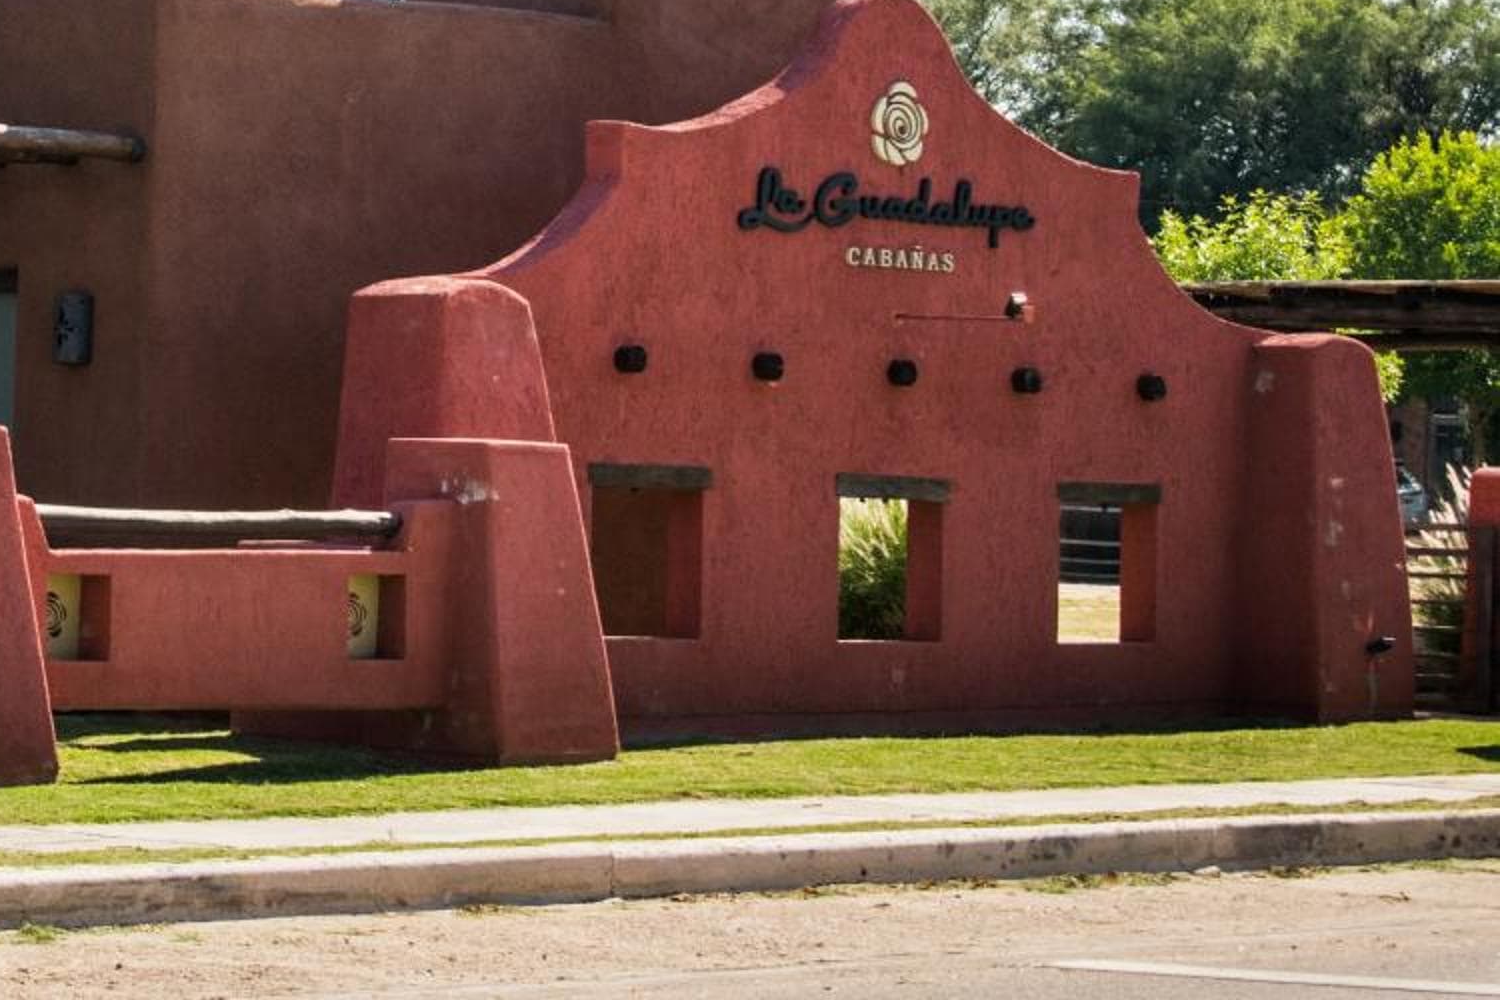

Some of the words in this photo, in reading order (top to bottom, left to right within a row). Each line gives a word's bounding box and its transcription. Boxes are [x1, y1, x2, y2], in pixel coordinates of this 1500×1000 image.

[737, 166, 813, 232] La
[813, 172, 1035, 248] Guadalupe
[846, 245, 956, 273] CABAÑAS
